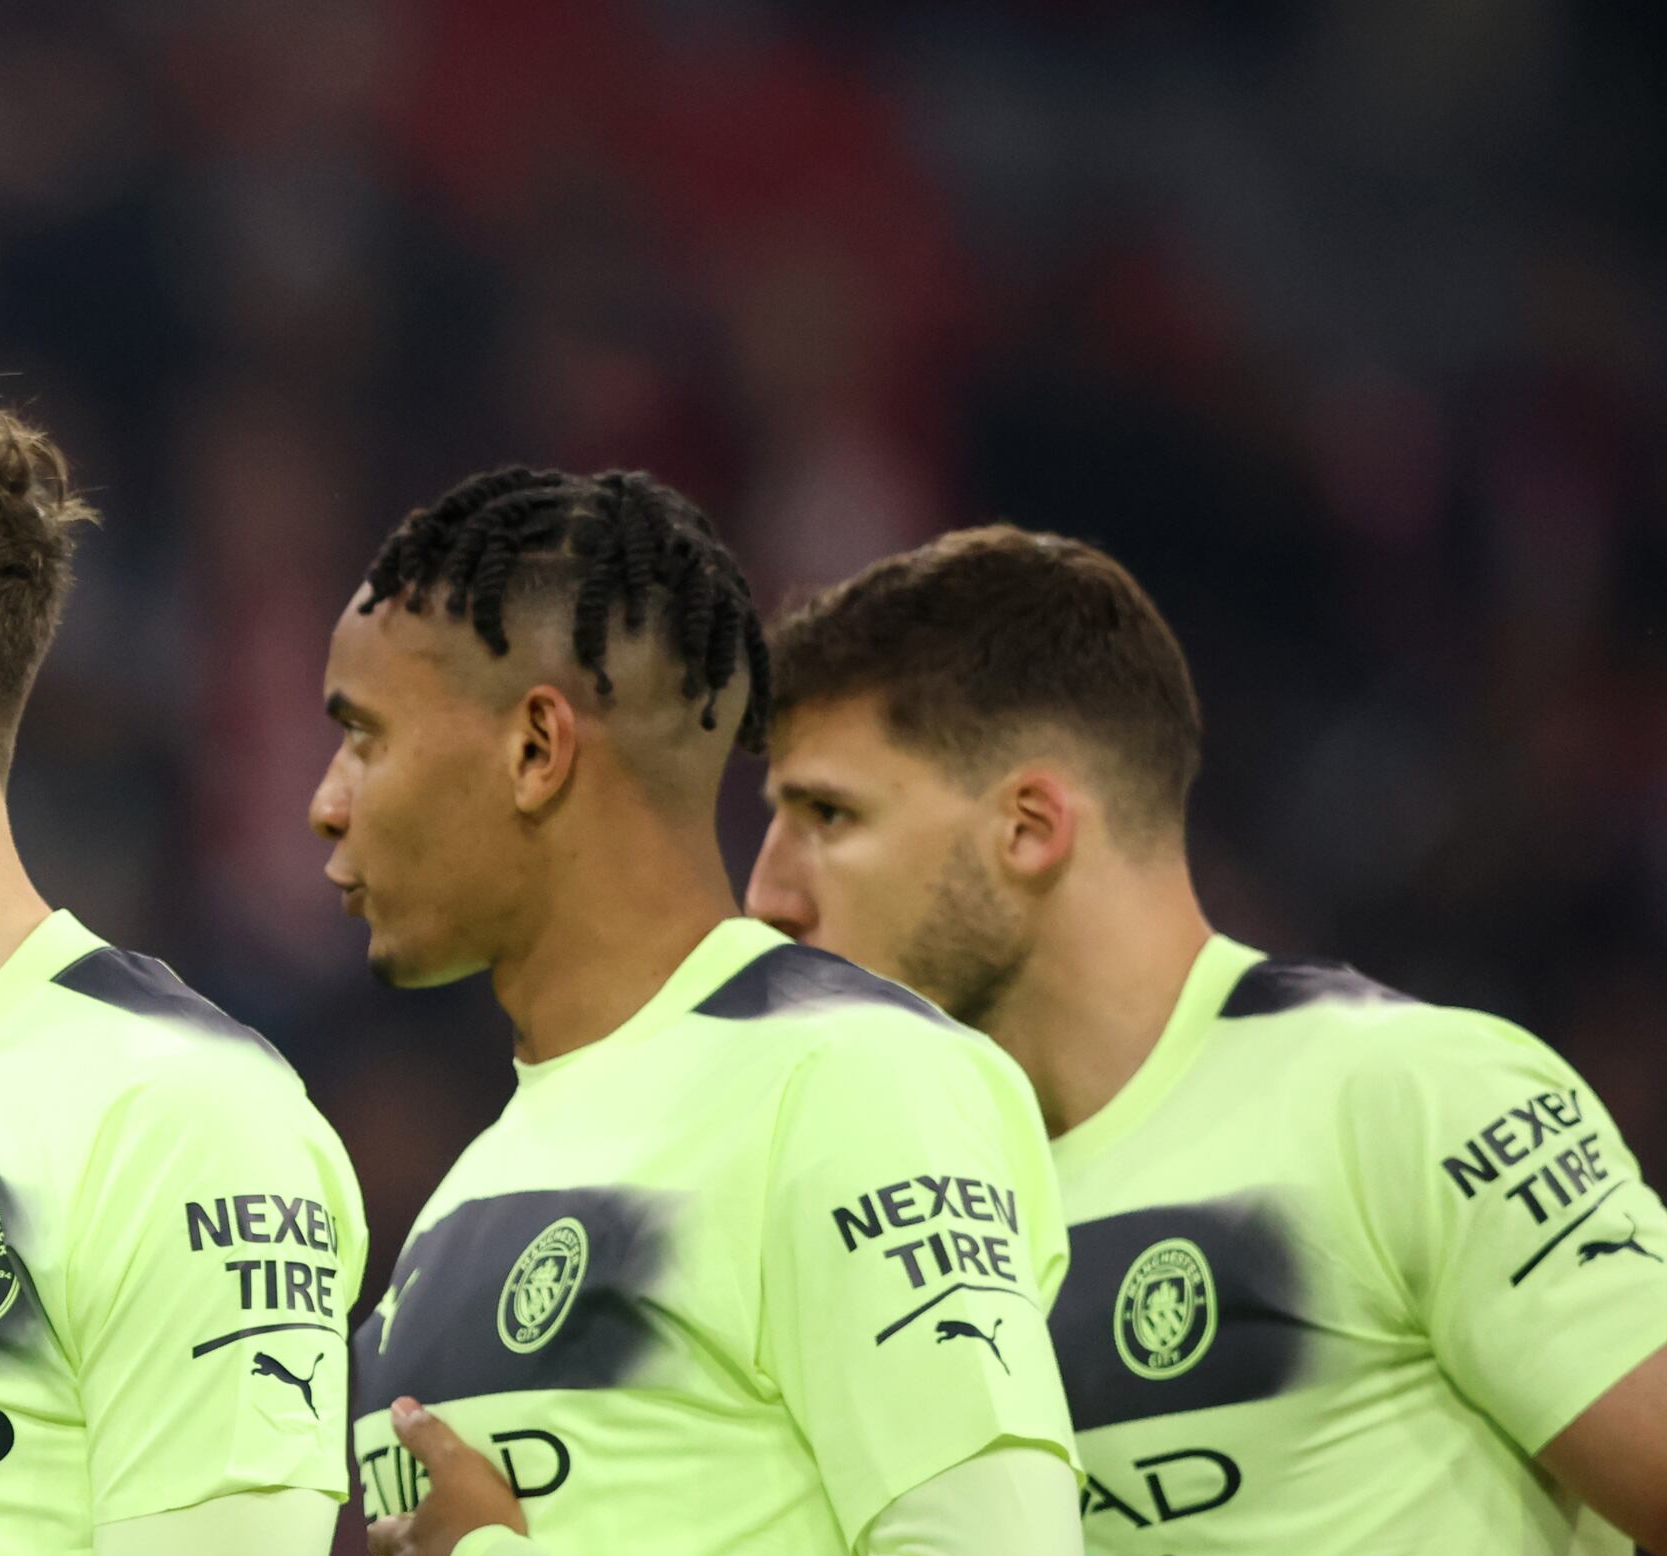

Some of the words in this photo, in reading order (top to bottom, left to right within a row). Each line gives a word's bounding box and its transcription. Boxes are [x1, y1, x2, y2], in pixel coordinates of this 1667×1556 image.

[1505, 1132, 1609, 1225] TIRE
[832, 1175, 1019, 1252] NEXEN
[225, 1260, 337, 1318] TIRE
[883, 1230, 1017, 1289] TIRE
